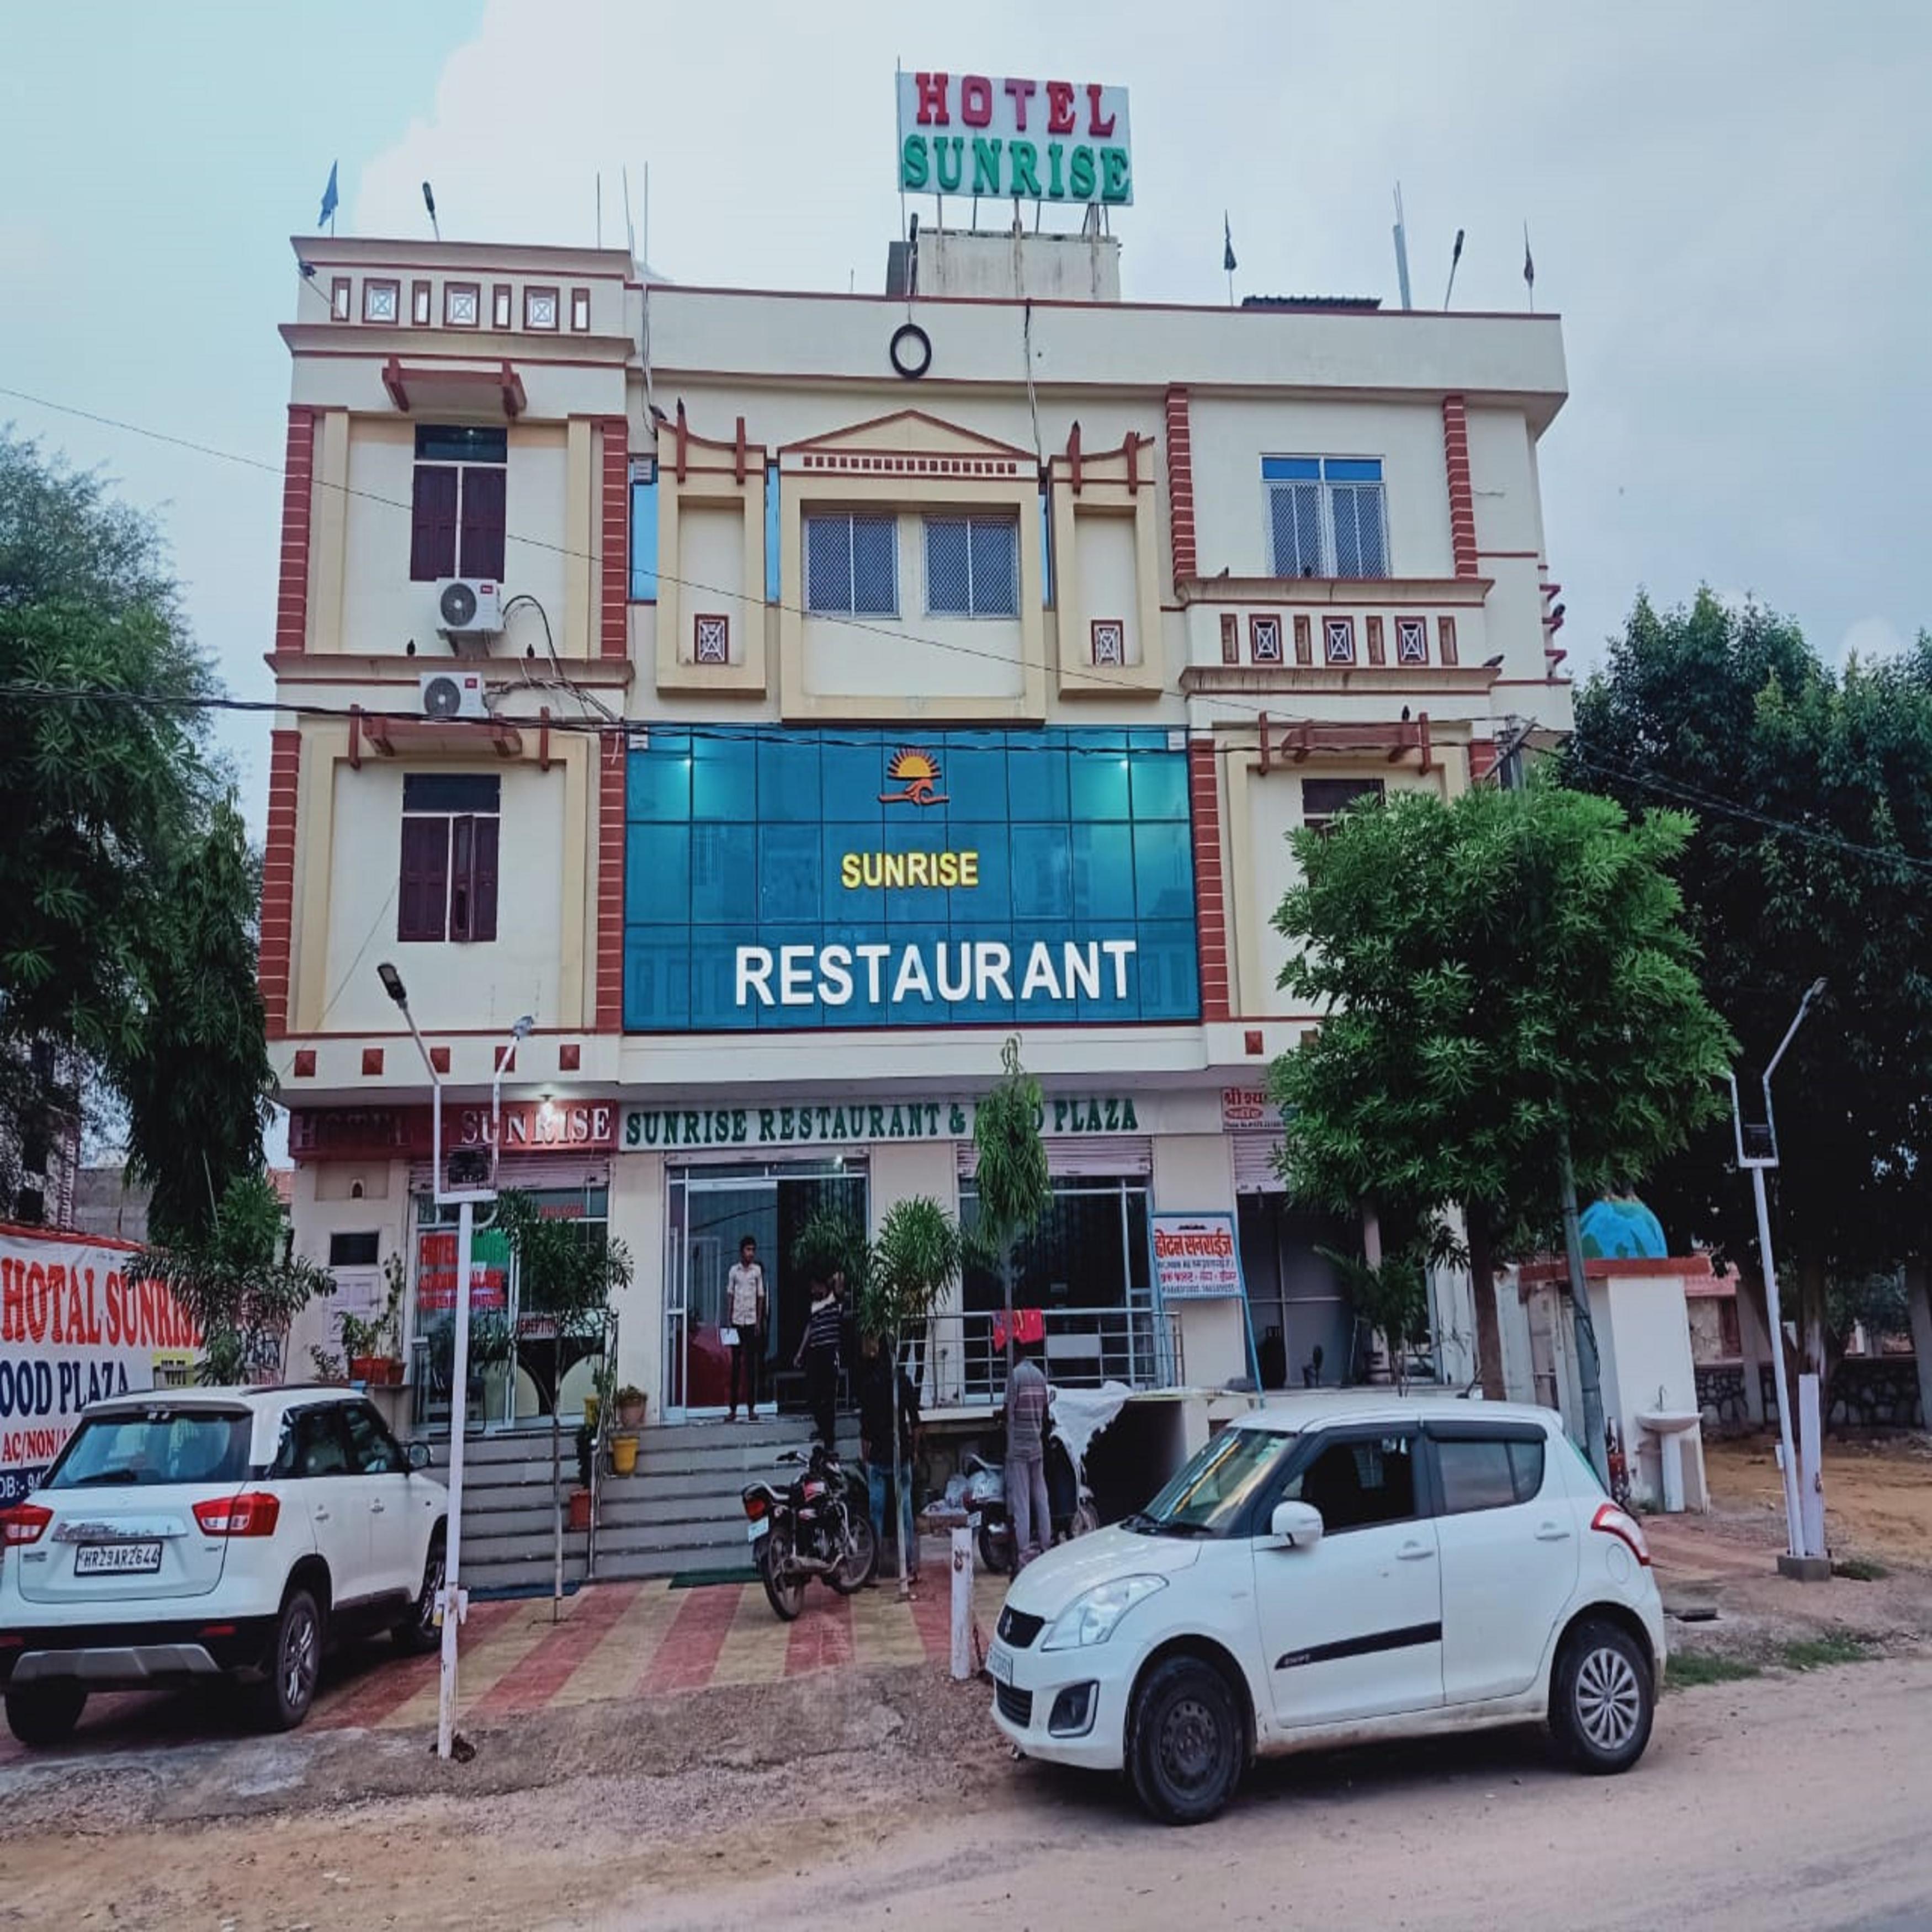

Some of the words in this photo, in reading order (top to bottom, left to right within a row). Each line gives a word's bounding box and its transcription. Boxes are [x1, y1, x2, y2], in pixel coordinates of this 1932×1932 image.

[915, 72, 1115, 137] HOTEL
[903, 134, 1130, 202] SUNRISE
[841, 851, 979, 889] SUNRISE
[735, 940, 1137, 1006] RESTAURANT
[461, 1107, 612, 1145] SUNRISE
[626, 1108, 747, 1145] SUNRISE
[758, 1102, 941, 1142] RESTAURANT
[949, 1102, 967, 1134] &
[1053, 1098, 1139, 1132] PLAZA
[1, 1257, 102, 1346] HOTAL
[0, 1359, 52, 1418] OOD
[57, 1359, 129, 1415] PLAZA
